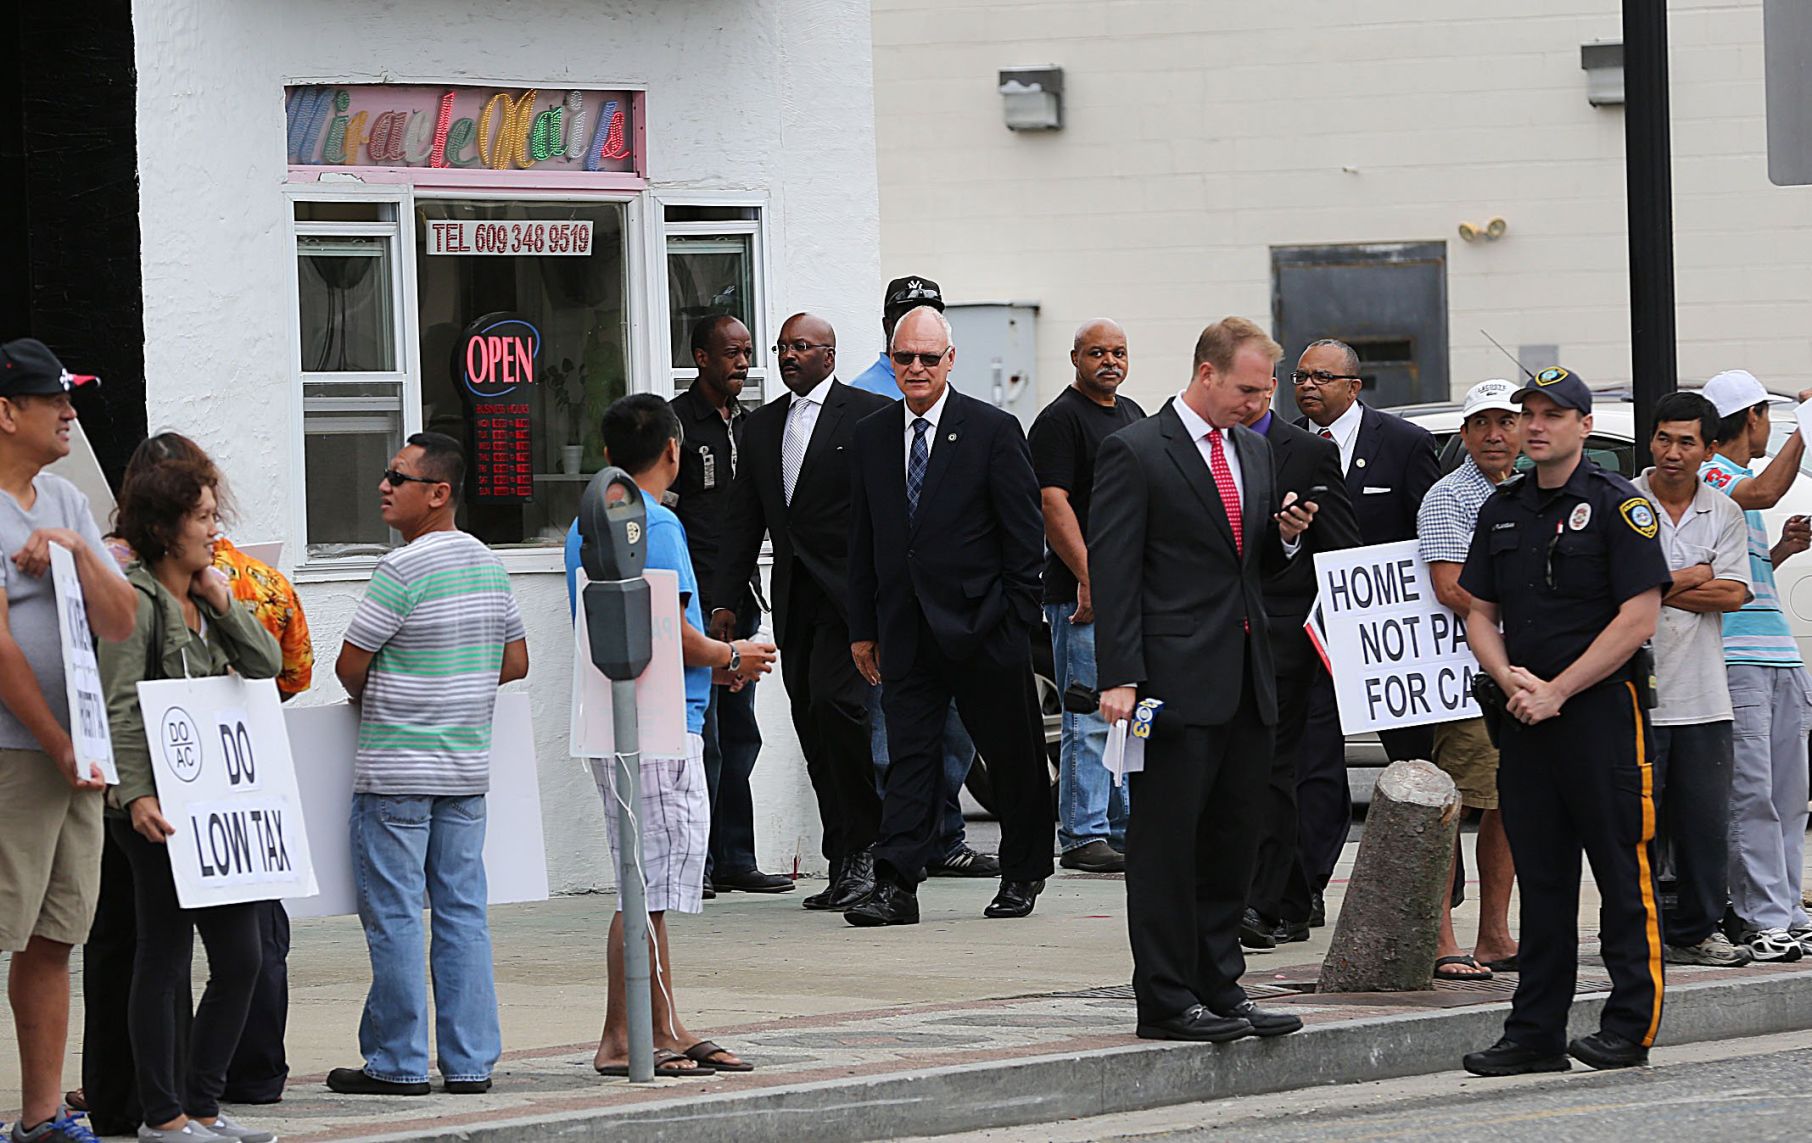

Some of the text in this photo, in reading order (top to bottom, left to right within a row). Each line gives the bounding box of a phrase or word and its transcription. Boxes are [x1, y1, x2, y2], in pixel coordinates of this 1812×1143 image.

[287, 86, 631, 172] Miracle Nails
[432, 222, 590, 254] TEL 609 348 9519
[466, 335, 534, 384] OPEN
[1327, 559, 1421, 612] HOME
[1359, 613, 1471, 665] NOT PA
[1365, 666, 1475, 721] FOR CA
[168, 721, 190, 743] DO
[175, 746, 195, 768] AC
[219, 720, 256, 786] DO
[190, 809, 292, 878] LOW TAX
